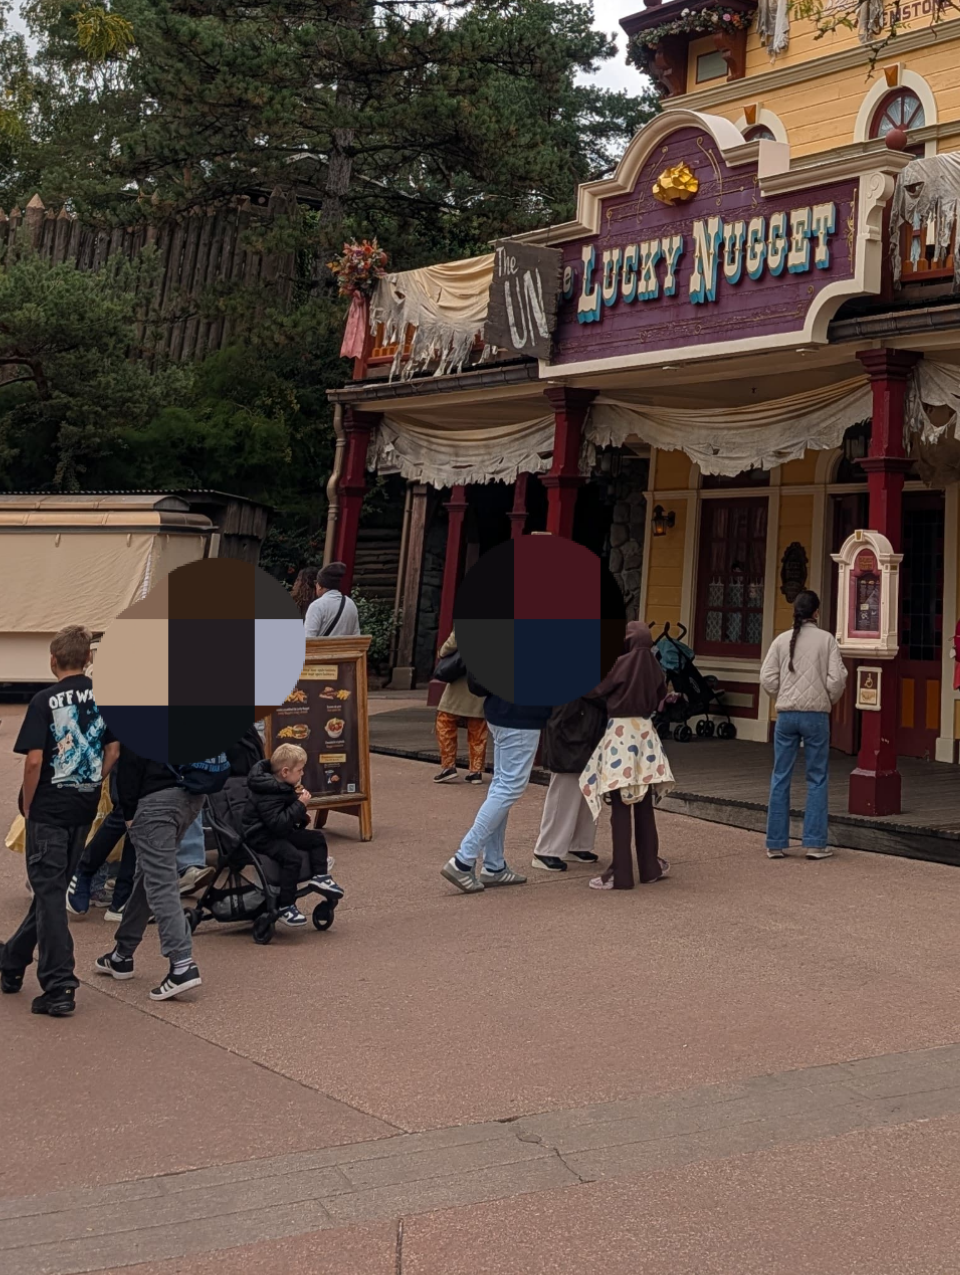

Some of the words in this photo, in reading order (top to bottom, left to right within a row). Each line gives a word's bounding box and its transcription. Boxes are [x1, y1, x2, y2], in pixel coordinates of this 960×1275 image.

[496, 246, 520, 277] The
[577, 234, 683, 325] LUCKY
[689, 201, 836, 305] NUGGET
[504, 268, 549, 349] UN
[49, 689, 74, 710] OFF
